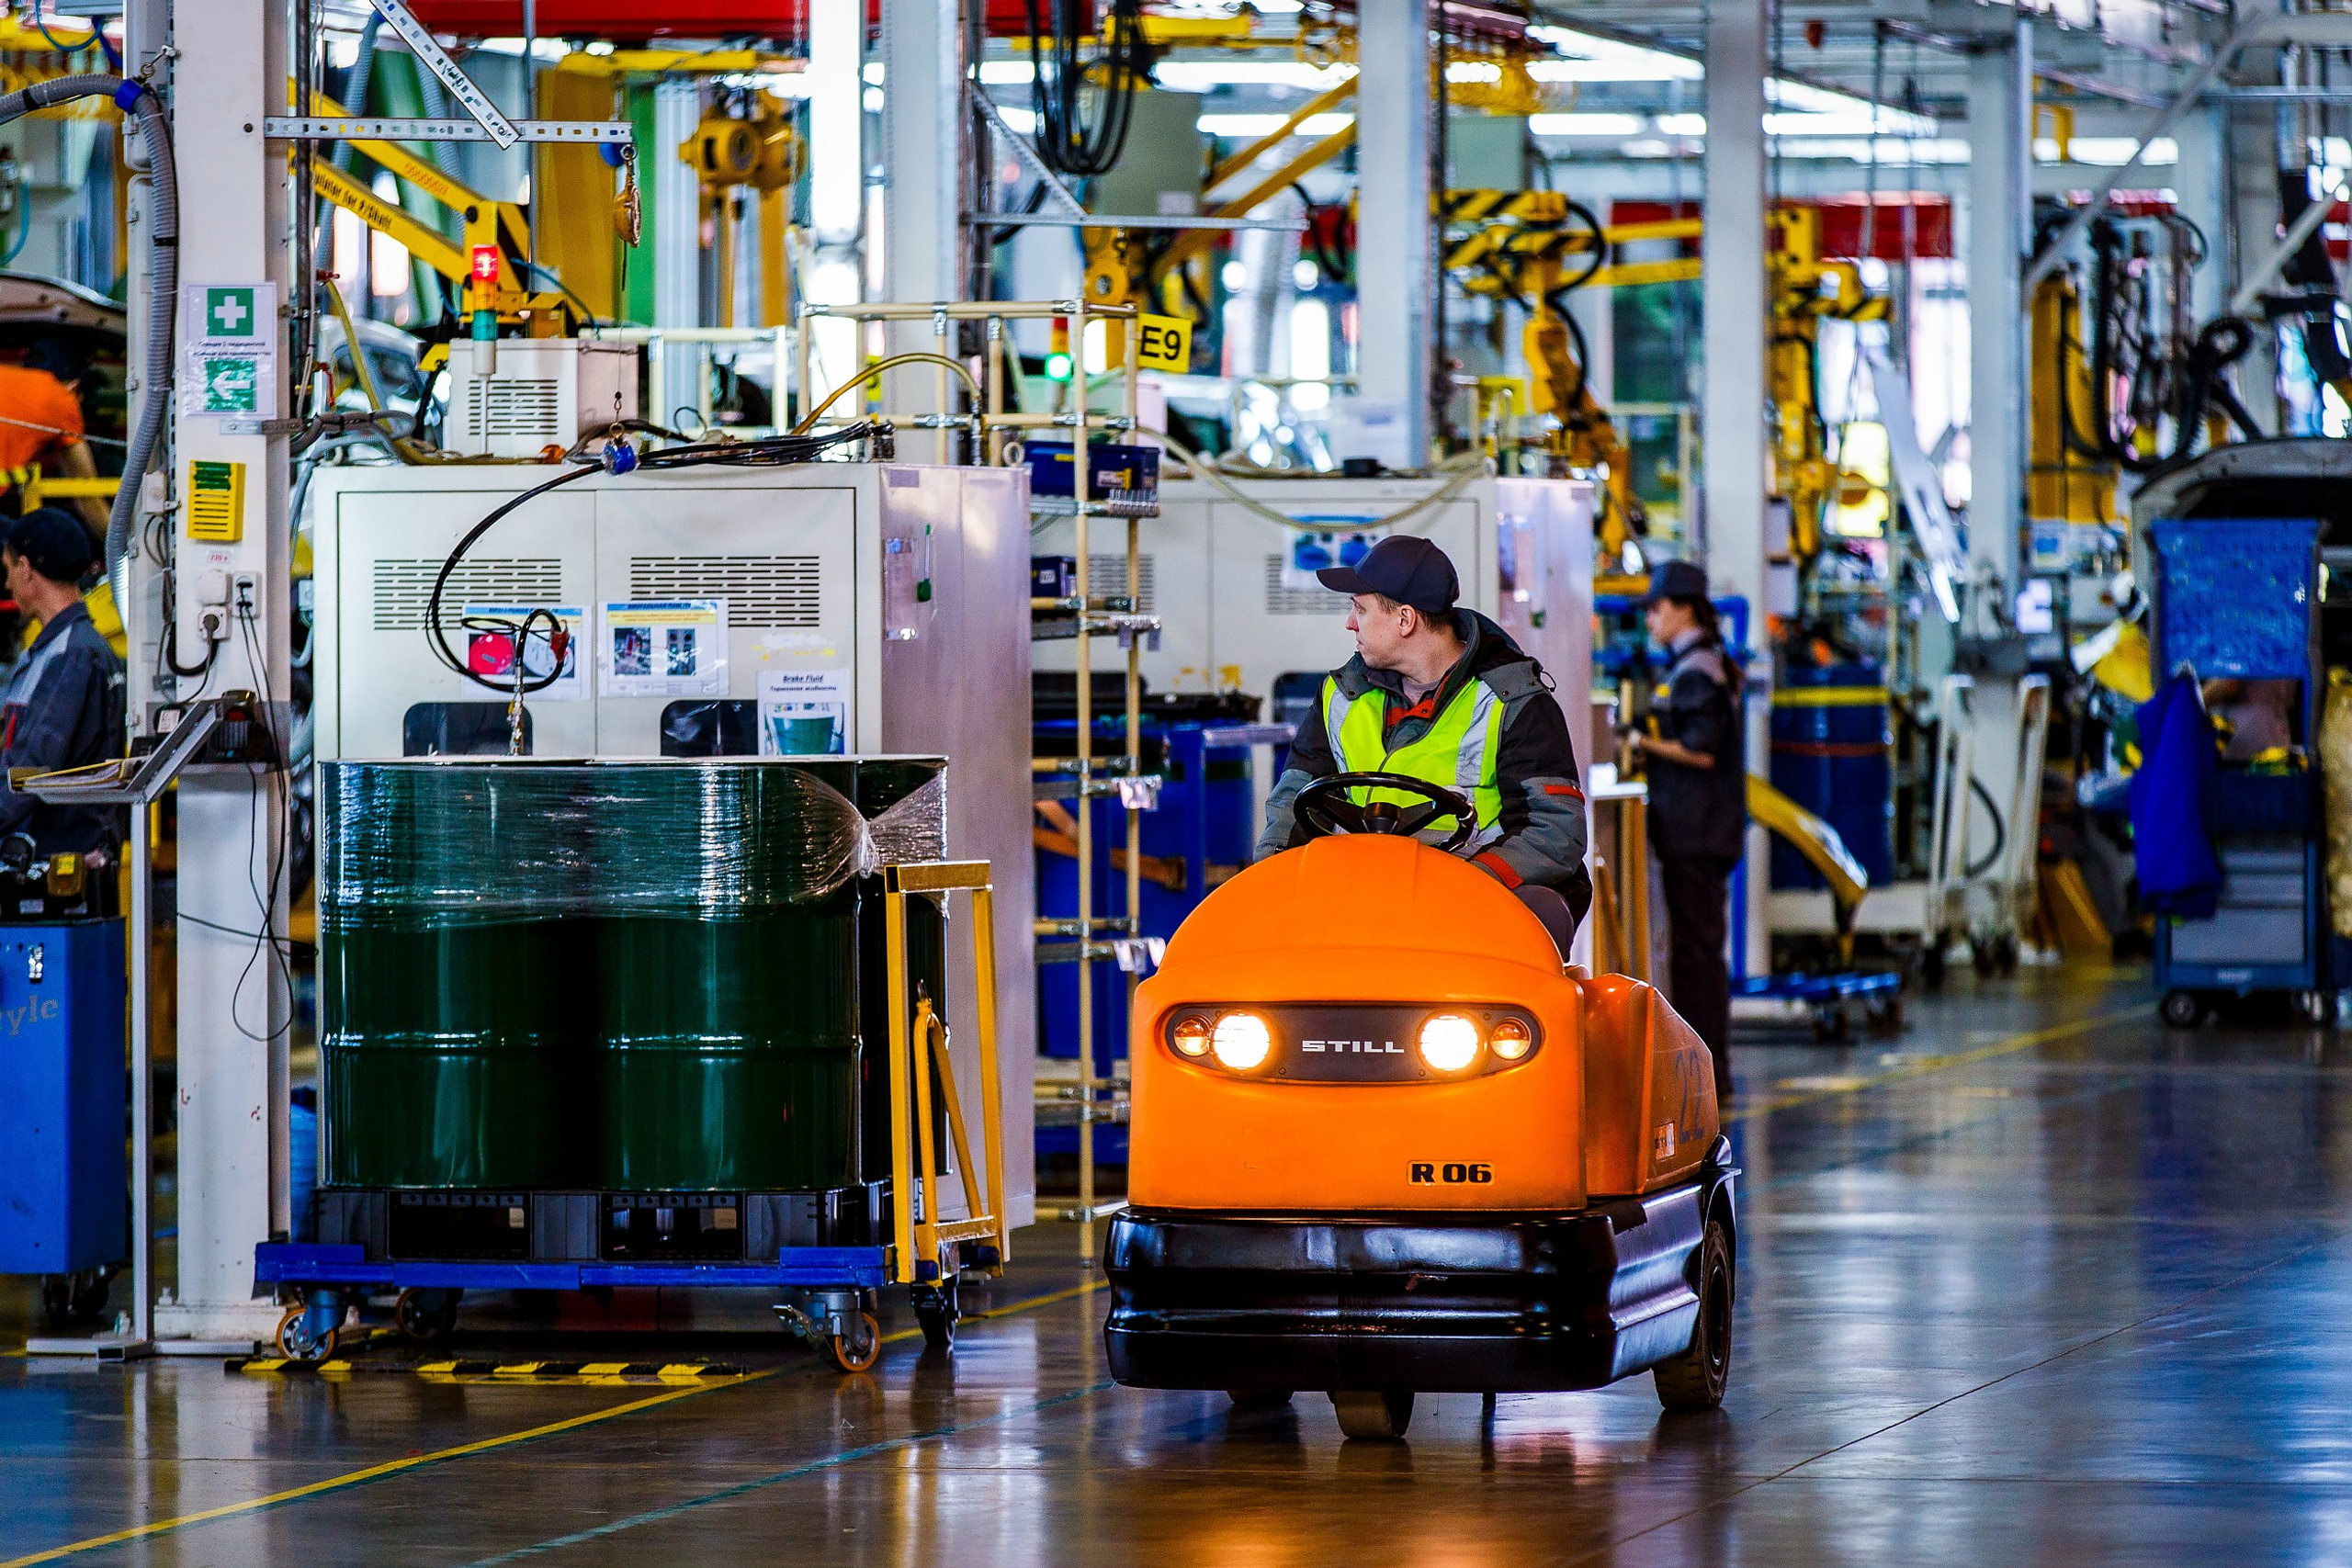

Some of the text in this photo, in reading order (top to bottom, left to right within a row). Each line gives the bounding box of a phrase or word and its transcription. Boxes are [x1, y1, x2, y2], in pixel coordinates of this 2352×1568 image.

[1140, 325, 1182, 361] E9
[783, 674, 824, 682] Brake Fluid
[0, 994, 59, 1036] yle
[1302, 1040, 1405, 1053] STILL
[1412, 1164, 1492, 1183] R 06
